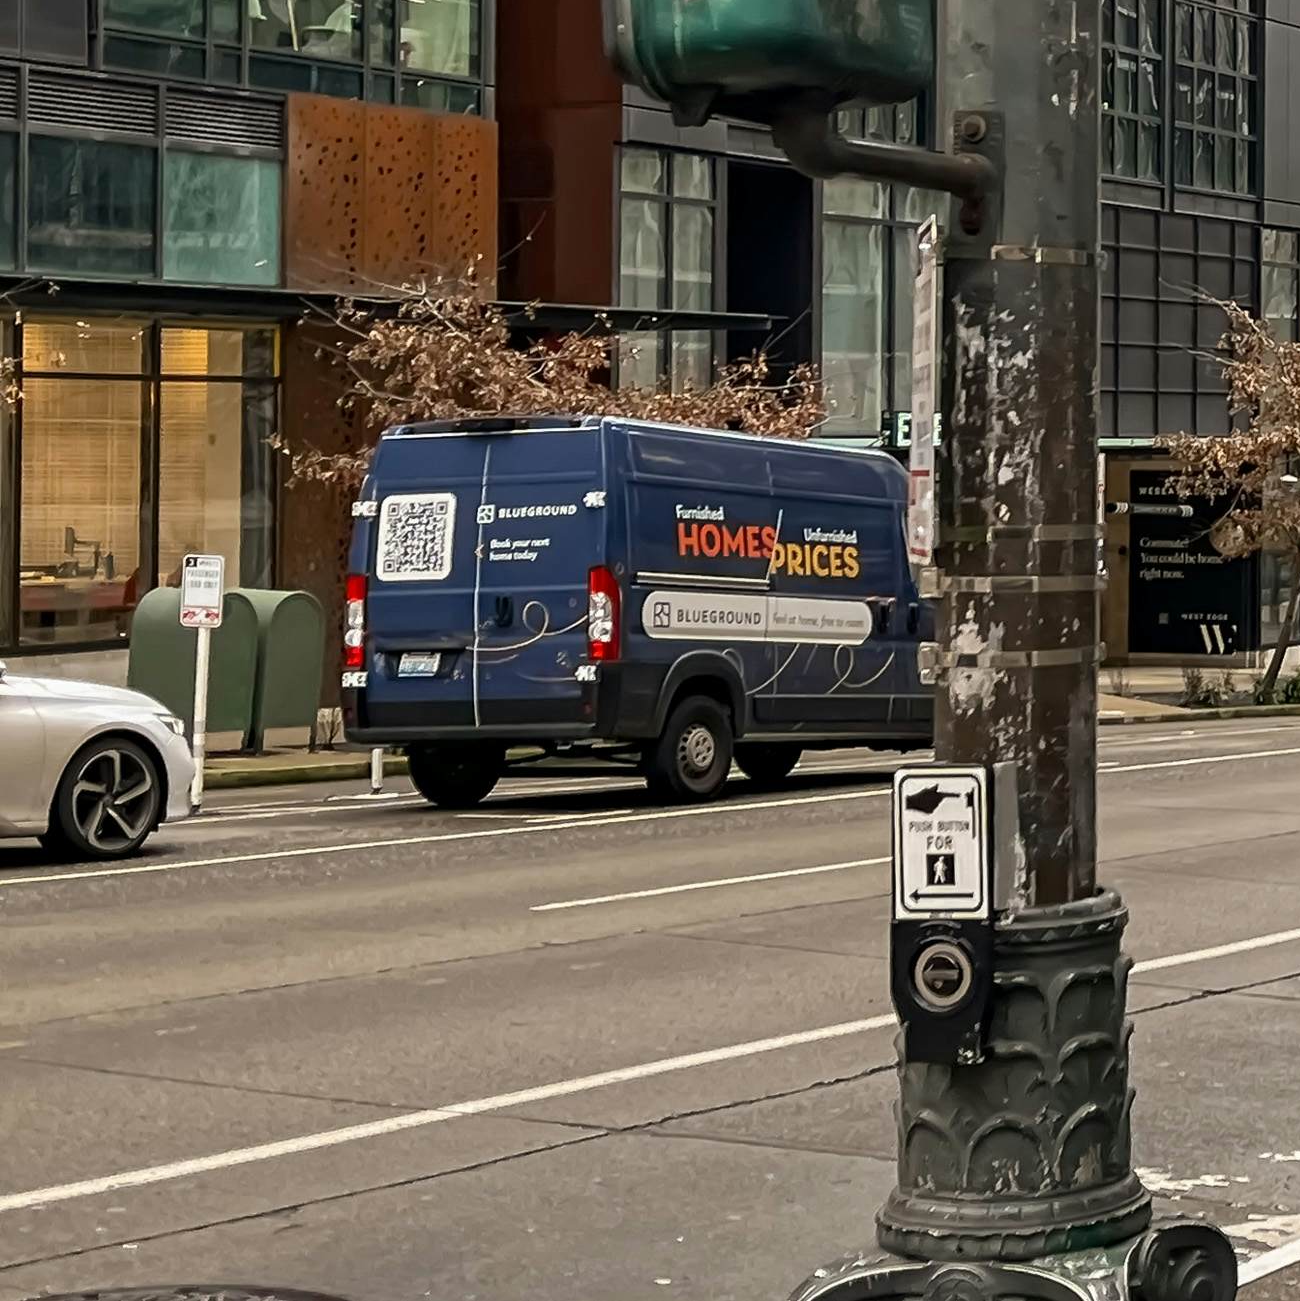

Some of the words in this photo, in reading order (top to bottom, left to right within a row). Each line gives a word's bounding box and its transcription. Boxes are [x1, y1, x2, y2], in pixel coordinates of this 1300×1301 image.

[498, 505, 578, 519] BLUEGROUND
[675, 504, 725, 521] Furnished
[678, 522, 776, 559] HOMES
[803, 527, 858, 544] Unfurnished
[770, 543, 860, 578] PRICES
[1141, 553, 1158, 563] You
[1159, 553, 1184, 563] could
[1185, 553, 1196, 563] be
[1140, 569, 1161, 581] right
[676, 609, 761, 625] BLUEGROUND
[908, 820, 933, 833] PUSH
[937, 820, 970, 833] BUTTON
[926, 835, 953, 851] FOR
